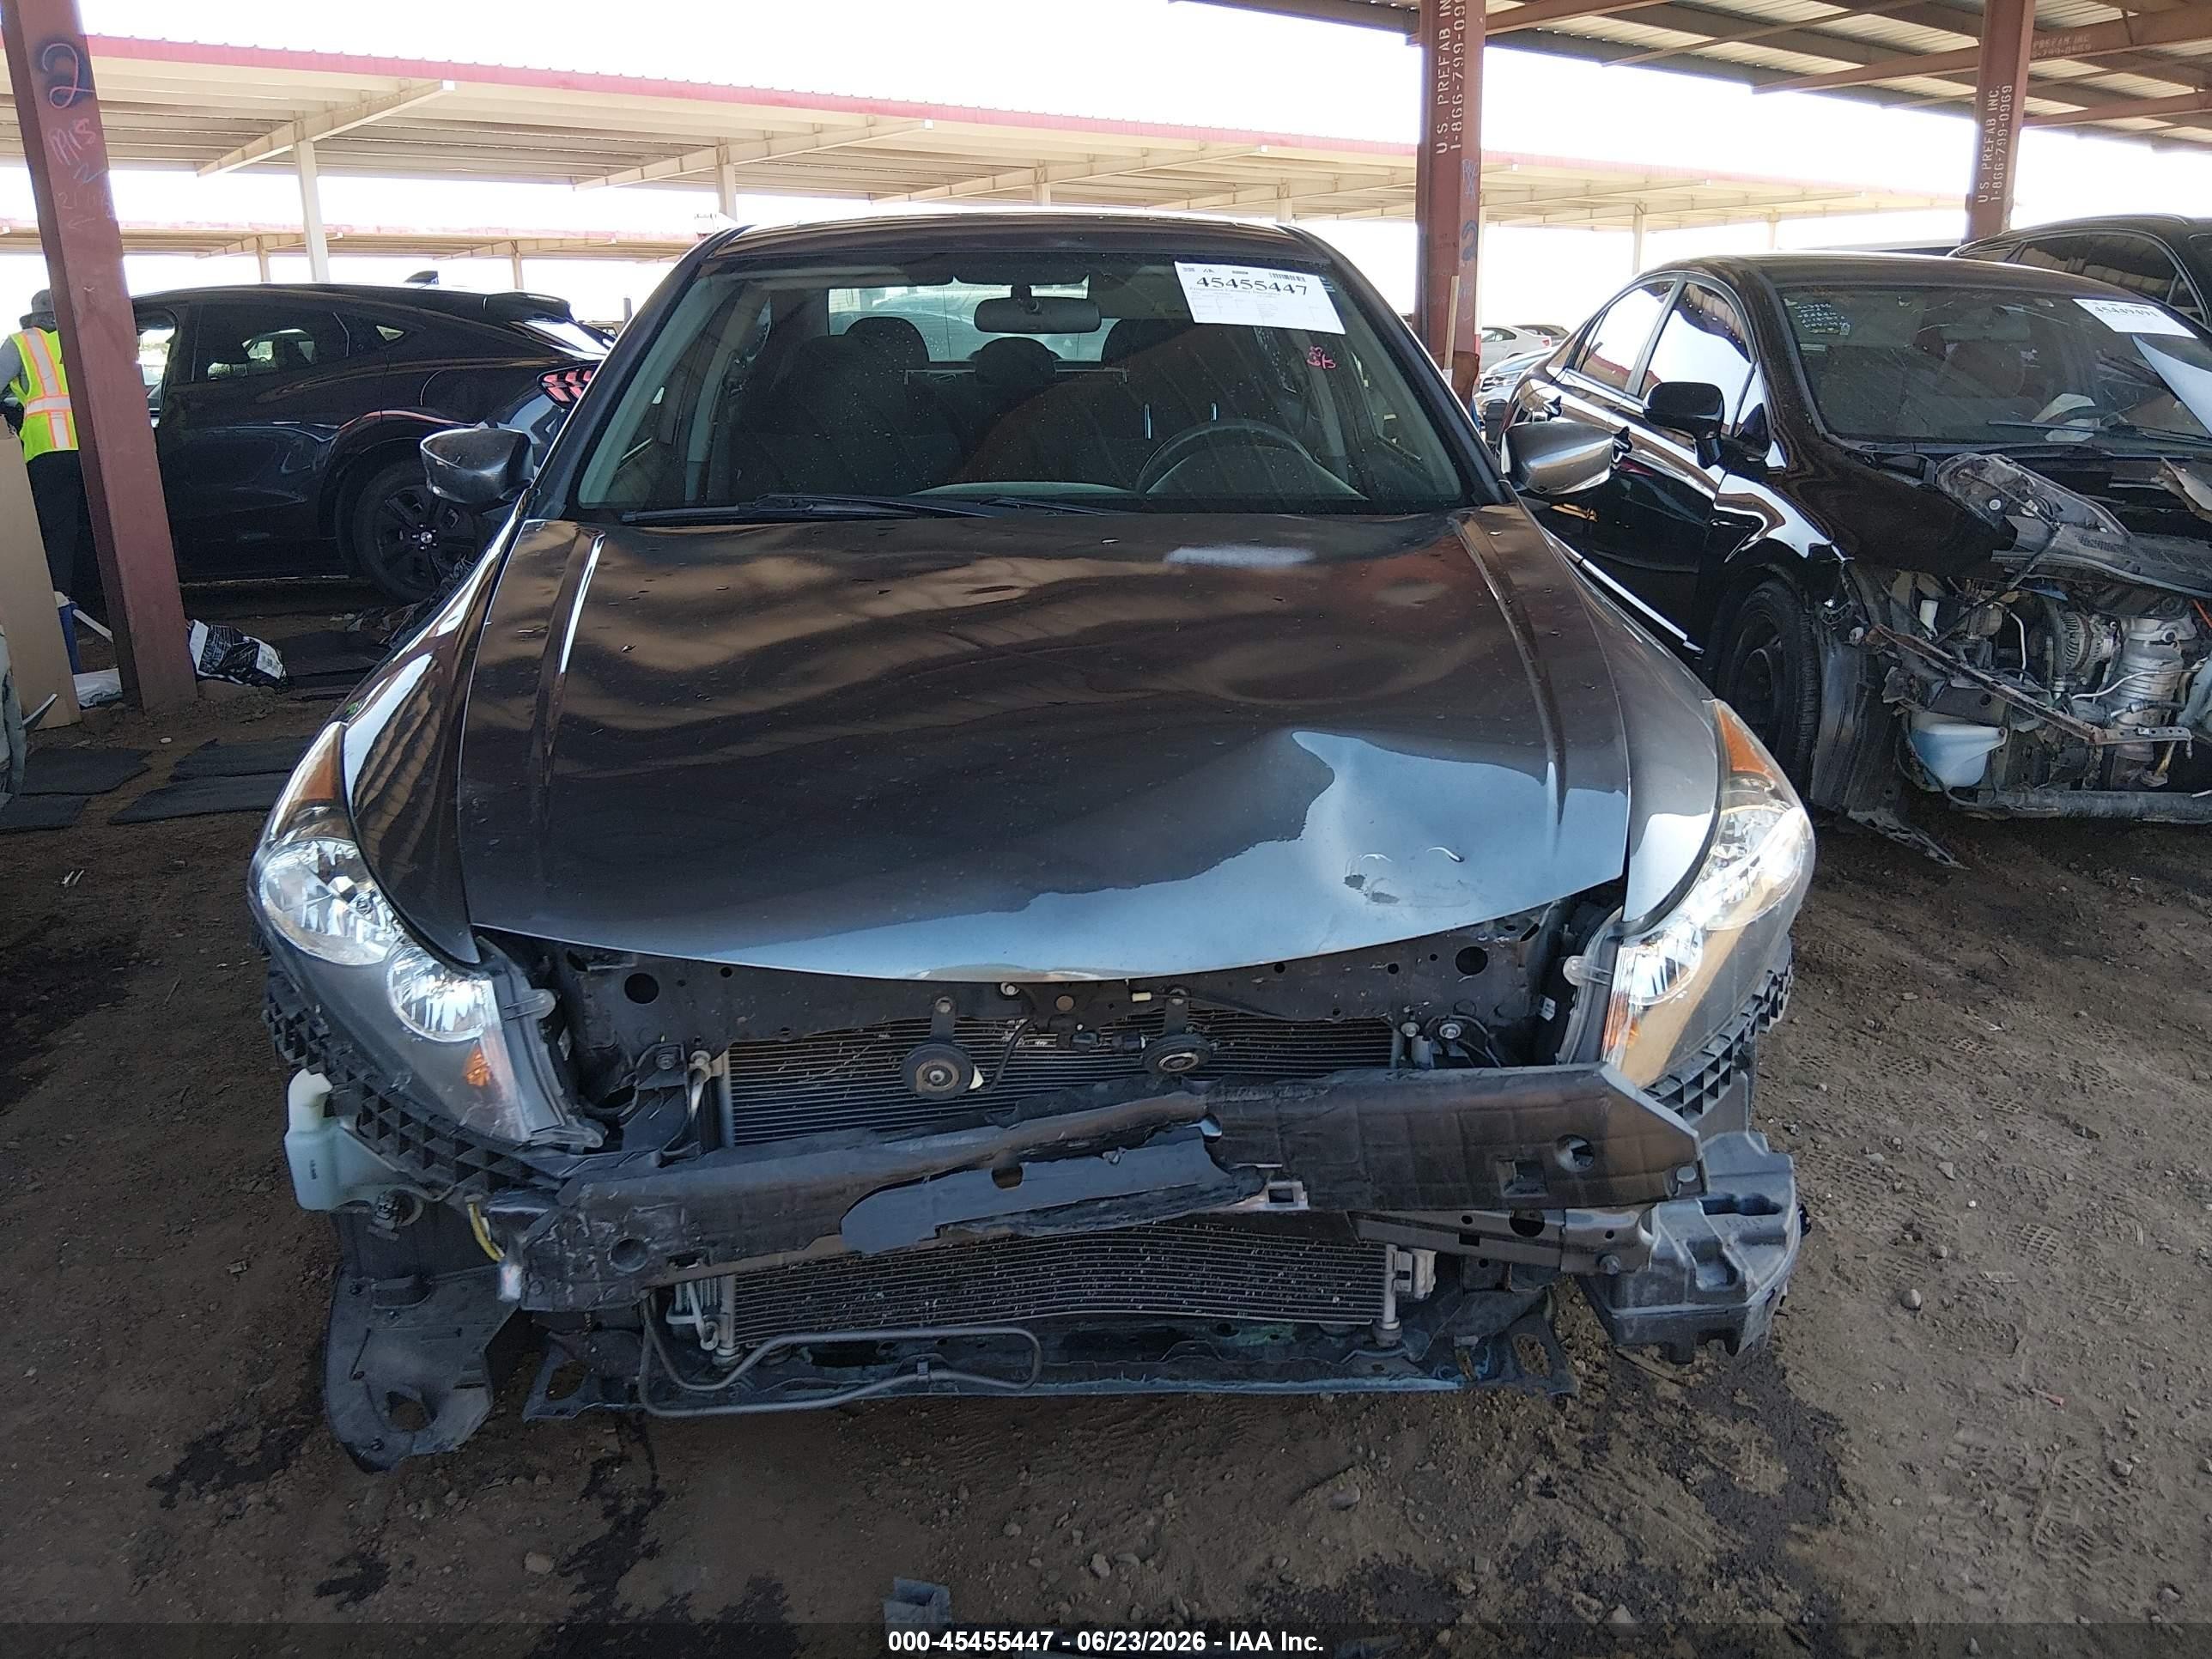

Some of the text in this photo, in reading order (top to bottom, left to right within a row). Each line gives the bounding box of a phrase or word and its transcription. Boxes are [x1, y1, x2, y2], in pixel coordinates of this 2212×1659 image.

[41, 42, 96, 110] 2
[1437, 27, 1452, 106] PREFAB
[1449, 0, 1467, 150] 1-866-799-09
[1987, 85, 2002, 112] INC.
[1436, 116, 1449, 155] U.S.
[1981, 118, 1997, 171] PREFAB
[1990, 84, 2014, 202] 1-866-799-0969
[1196, 276, 1308, 296] 45455447
